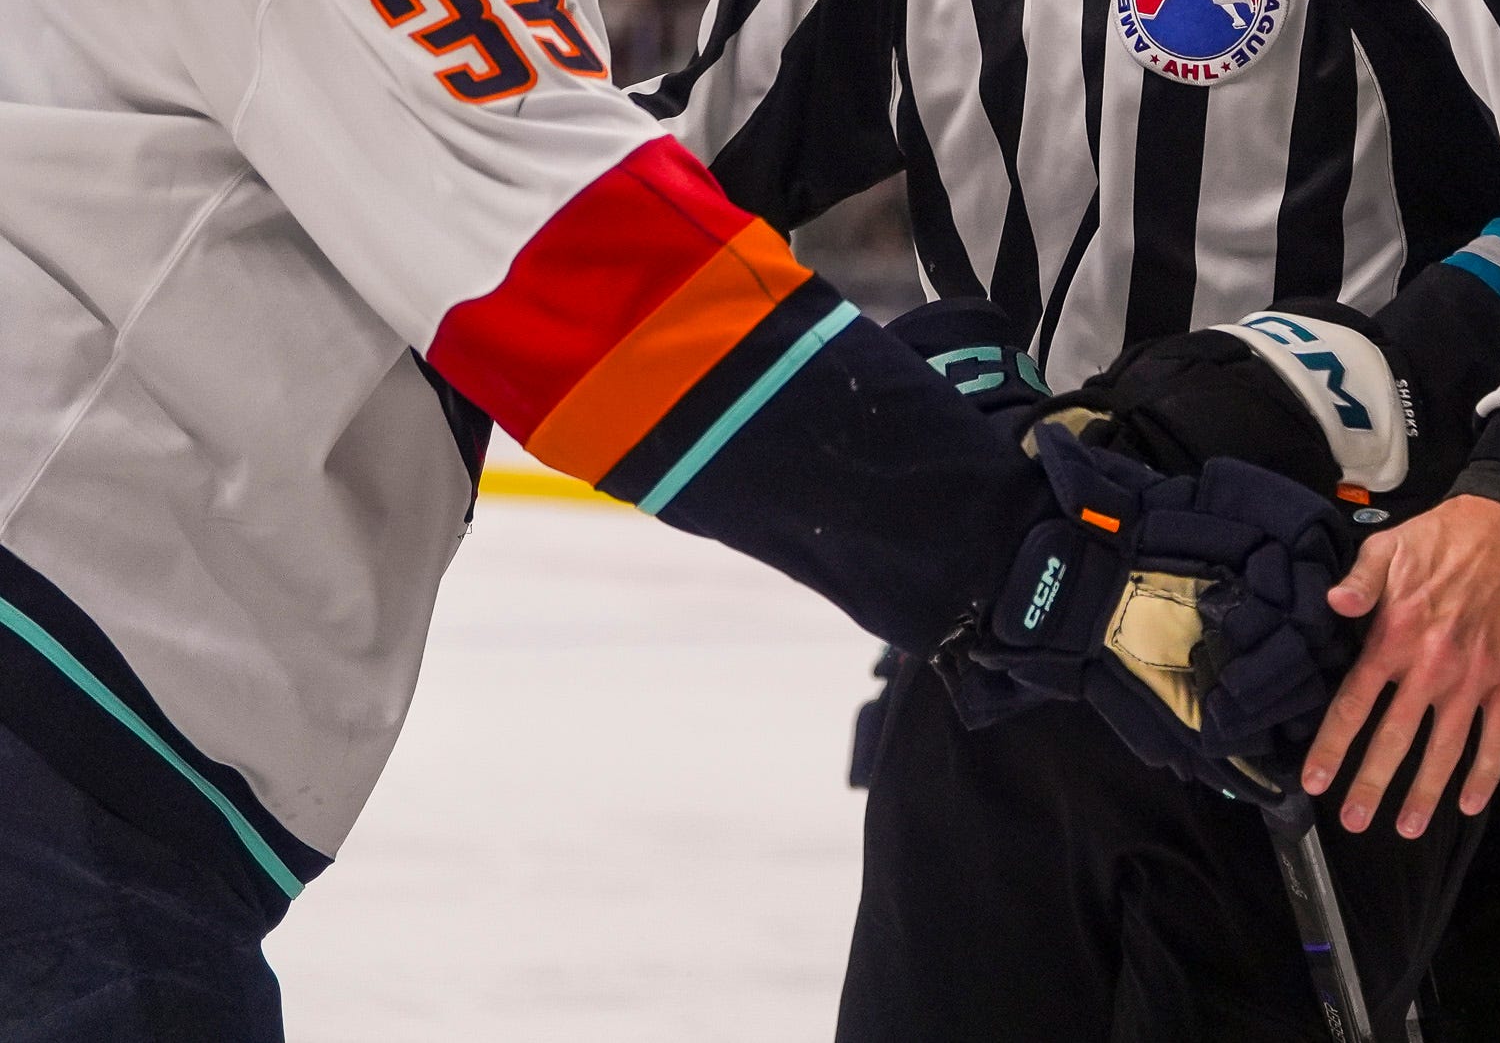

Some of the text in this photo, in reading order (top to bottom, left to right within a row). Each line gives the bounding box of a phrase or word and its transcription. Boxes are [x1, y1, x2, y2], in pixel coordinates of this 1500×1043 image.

[1162, 59, 1219, 80] AHL
[1241, 315, 1373, 431] CM
[1395, 378, 1419, 438] SHARKS
[1024, 556, 1061, 630] CCM
